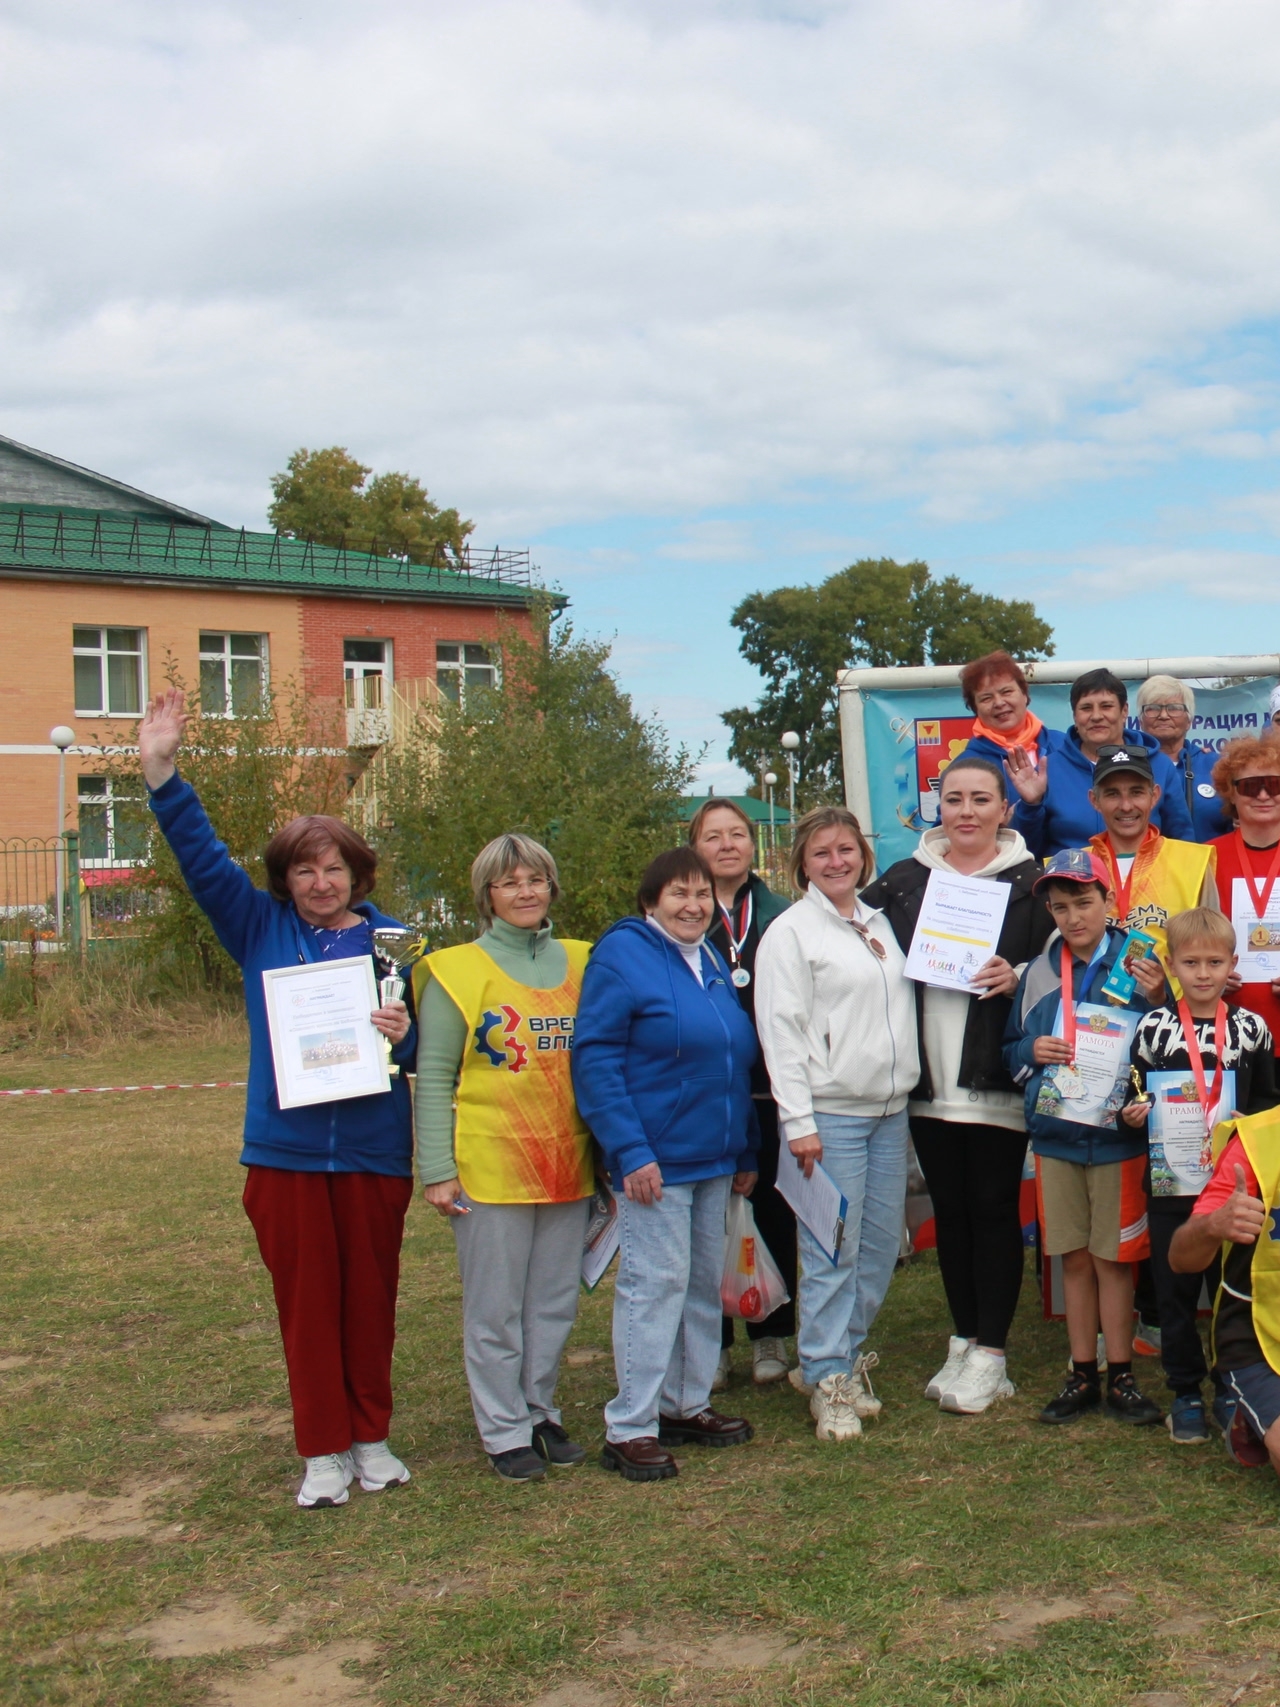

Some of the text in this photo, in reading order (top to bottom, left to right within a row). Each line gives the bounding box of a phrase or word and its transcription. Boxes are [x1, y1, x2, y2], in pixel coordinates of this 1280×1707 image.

[1257, 931, 1262, 939] 1
[1078, 1034, 1115, 1049] РАМОТА
[1169, 1106, 1202, 1115] ГРАМО
